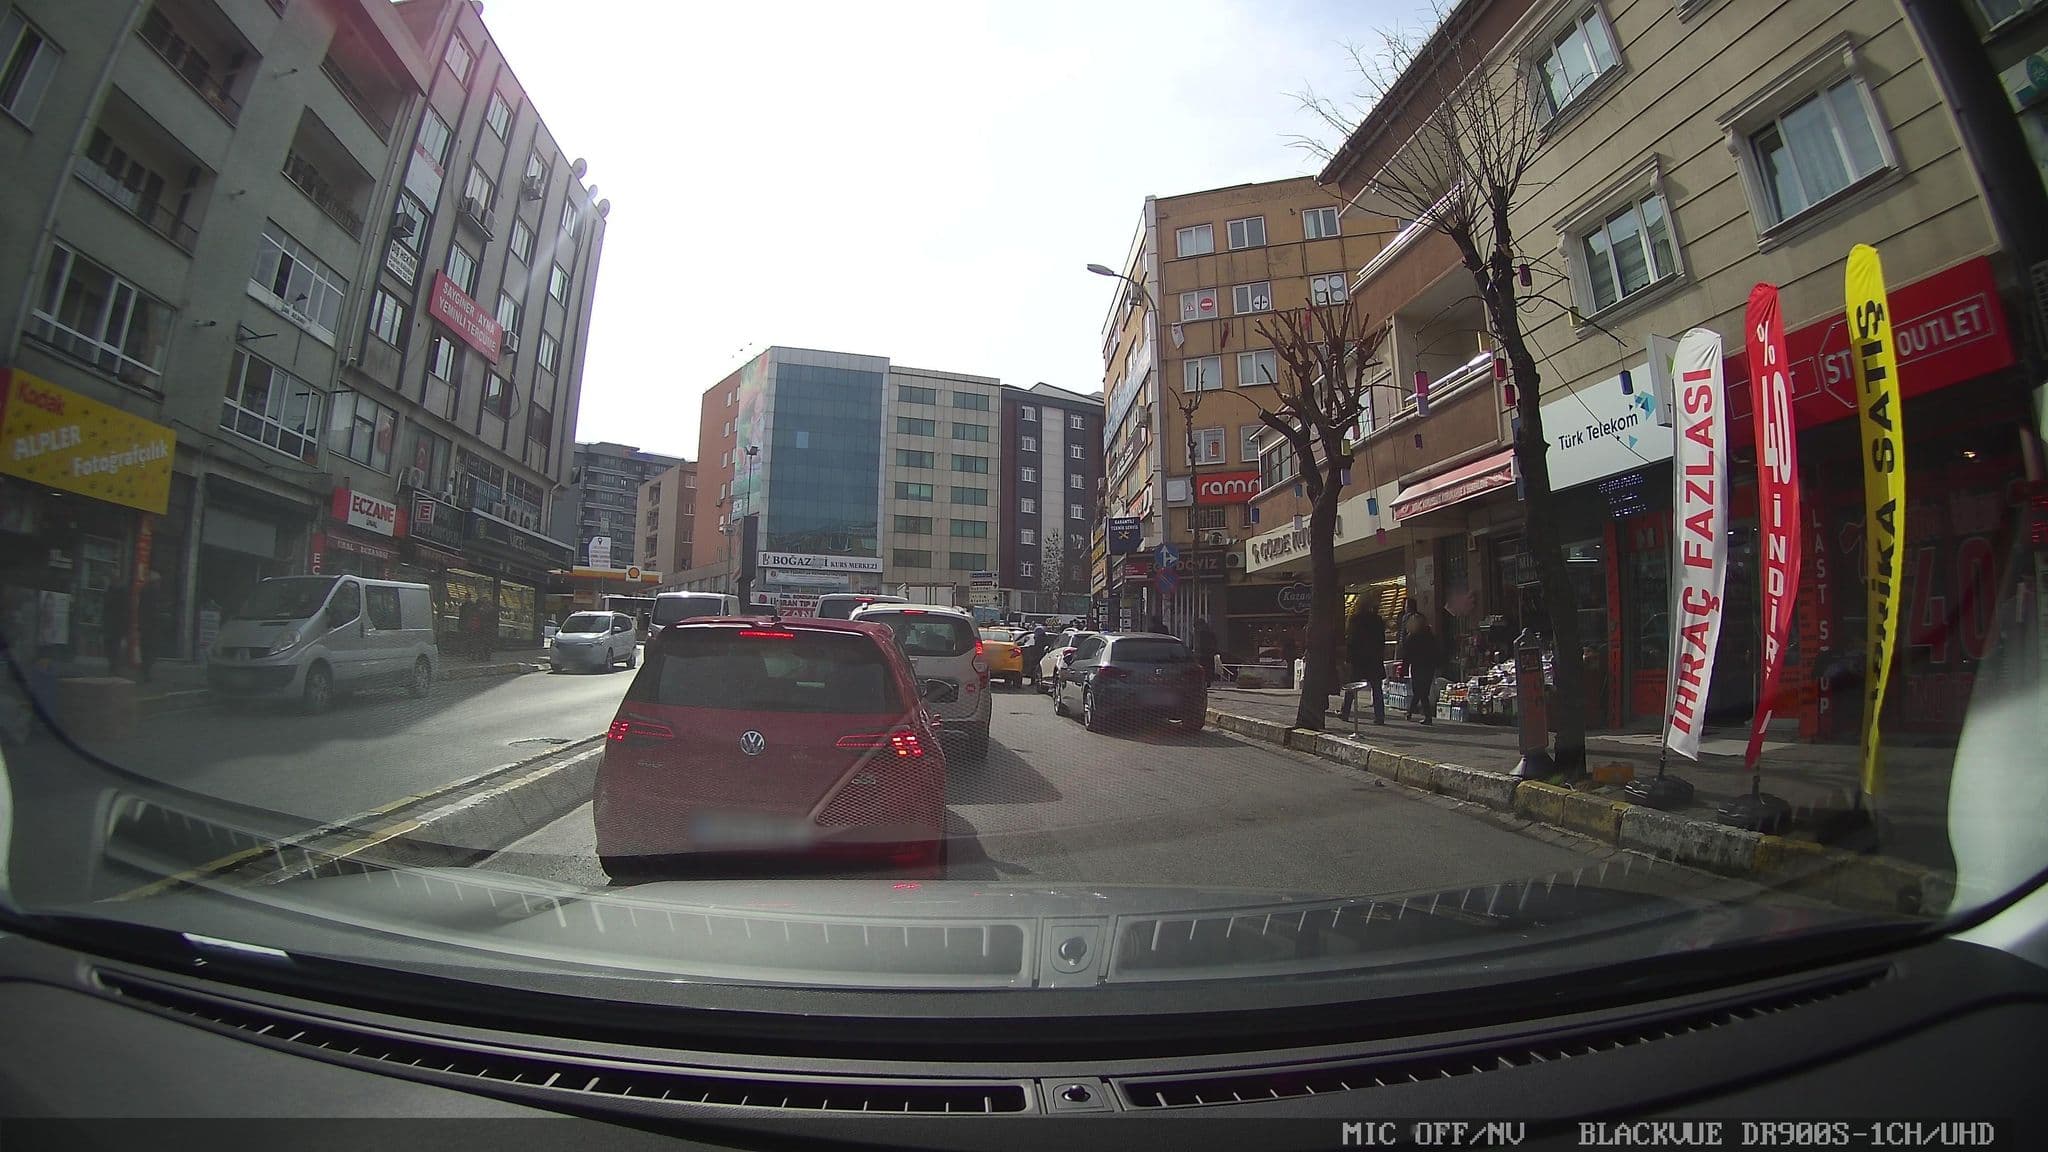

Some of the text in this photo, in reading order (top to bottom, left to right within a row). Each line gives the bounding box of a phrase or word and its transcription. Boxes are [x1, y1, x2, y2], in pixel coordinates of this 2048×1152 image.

[1825, 351, 1853, 385] ST
[1898, 303, 1981, 357] OUTLET
[20, 380, 66, 417] Kodak
[1856, 299, 1895, 474] SATIŞ
[14, 424, 82, 462] ALPLER
[1558, 412, 1639, 451] Türk Telekom
[1760, 370, 1792, 485] 40
[1682, 367, 1715, 570] FAZLASI
[352, 494, 395, 524] ECZANE
[773, 554, 828, 568] BOĞAZİ
[848, 562, 879, 570] MERKEZİ
[1812, 508, 1828, 605] LAST
